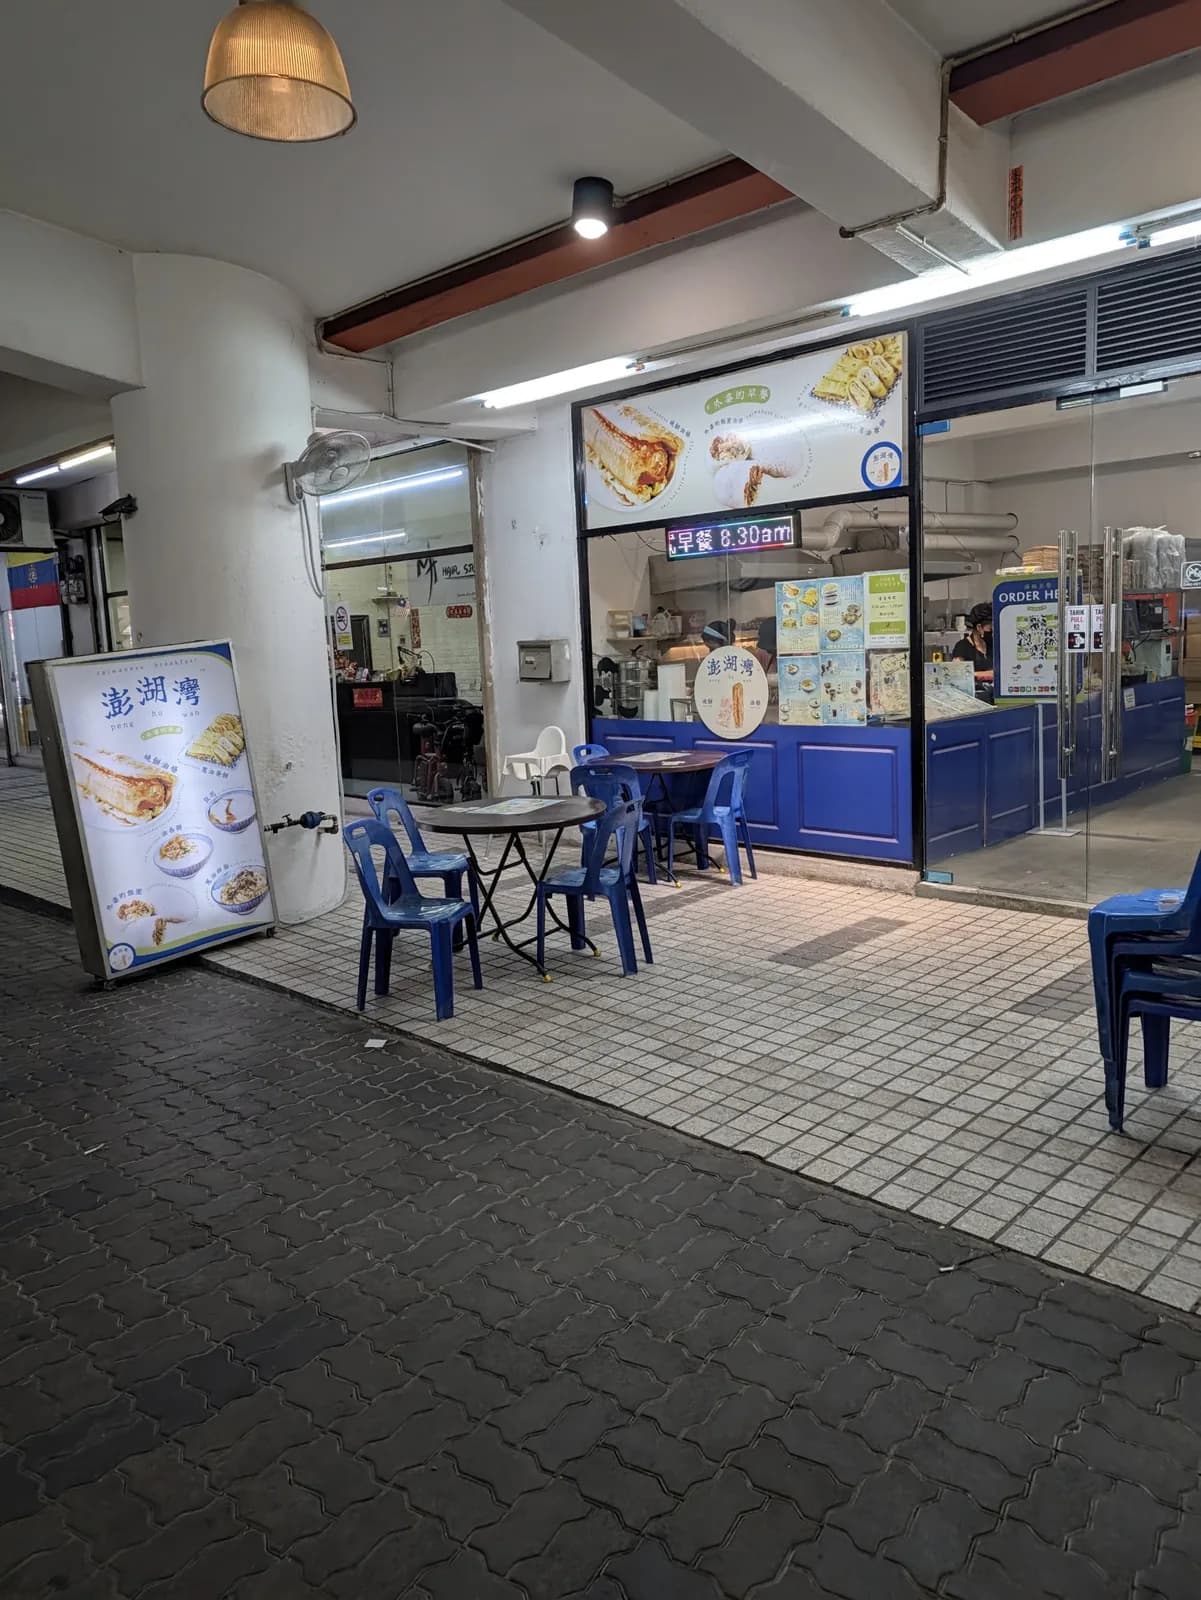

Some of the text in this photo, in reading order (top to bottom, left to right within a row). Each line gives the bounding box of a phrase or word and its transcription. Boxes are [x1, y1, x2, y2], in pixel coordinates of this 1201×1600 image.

[720, 525, 791, 548] 8.30am
[442, 565, 461, 577] HAIR
[998, 592, 1040, 603] ORDER
[707, 655, 754, 677] 澎湖灣
[101, 674, 201, 720] 澎湖灣
